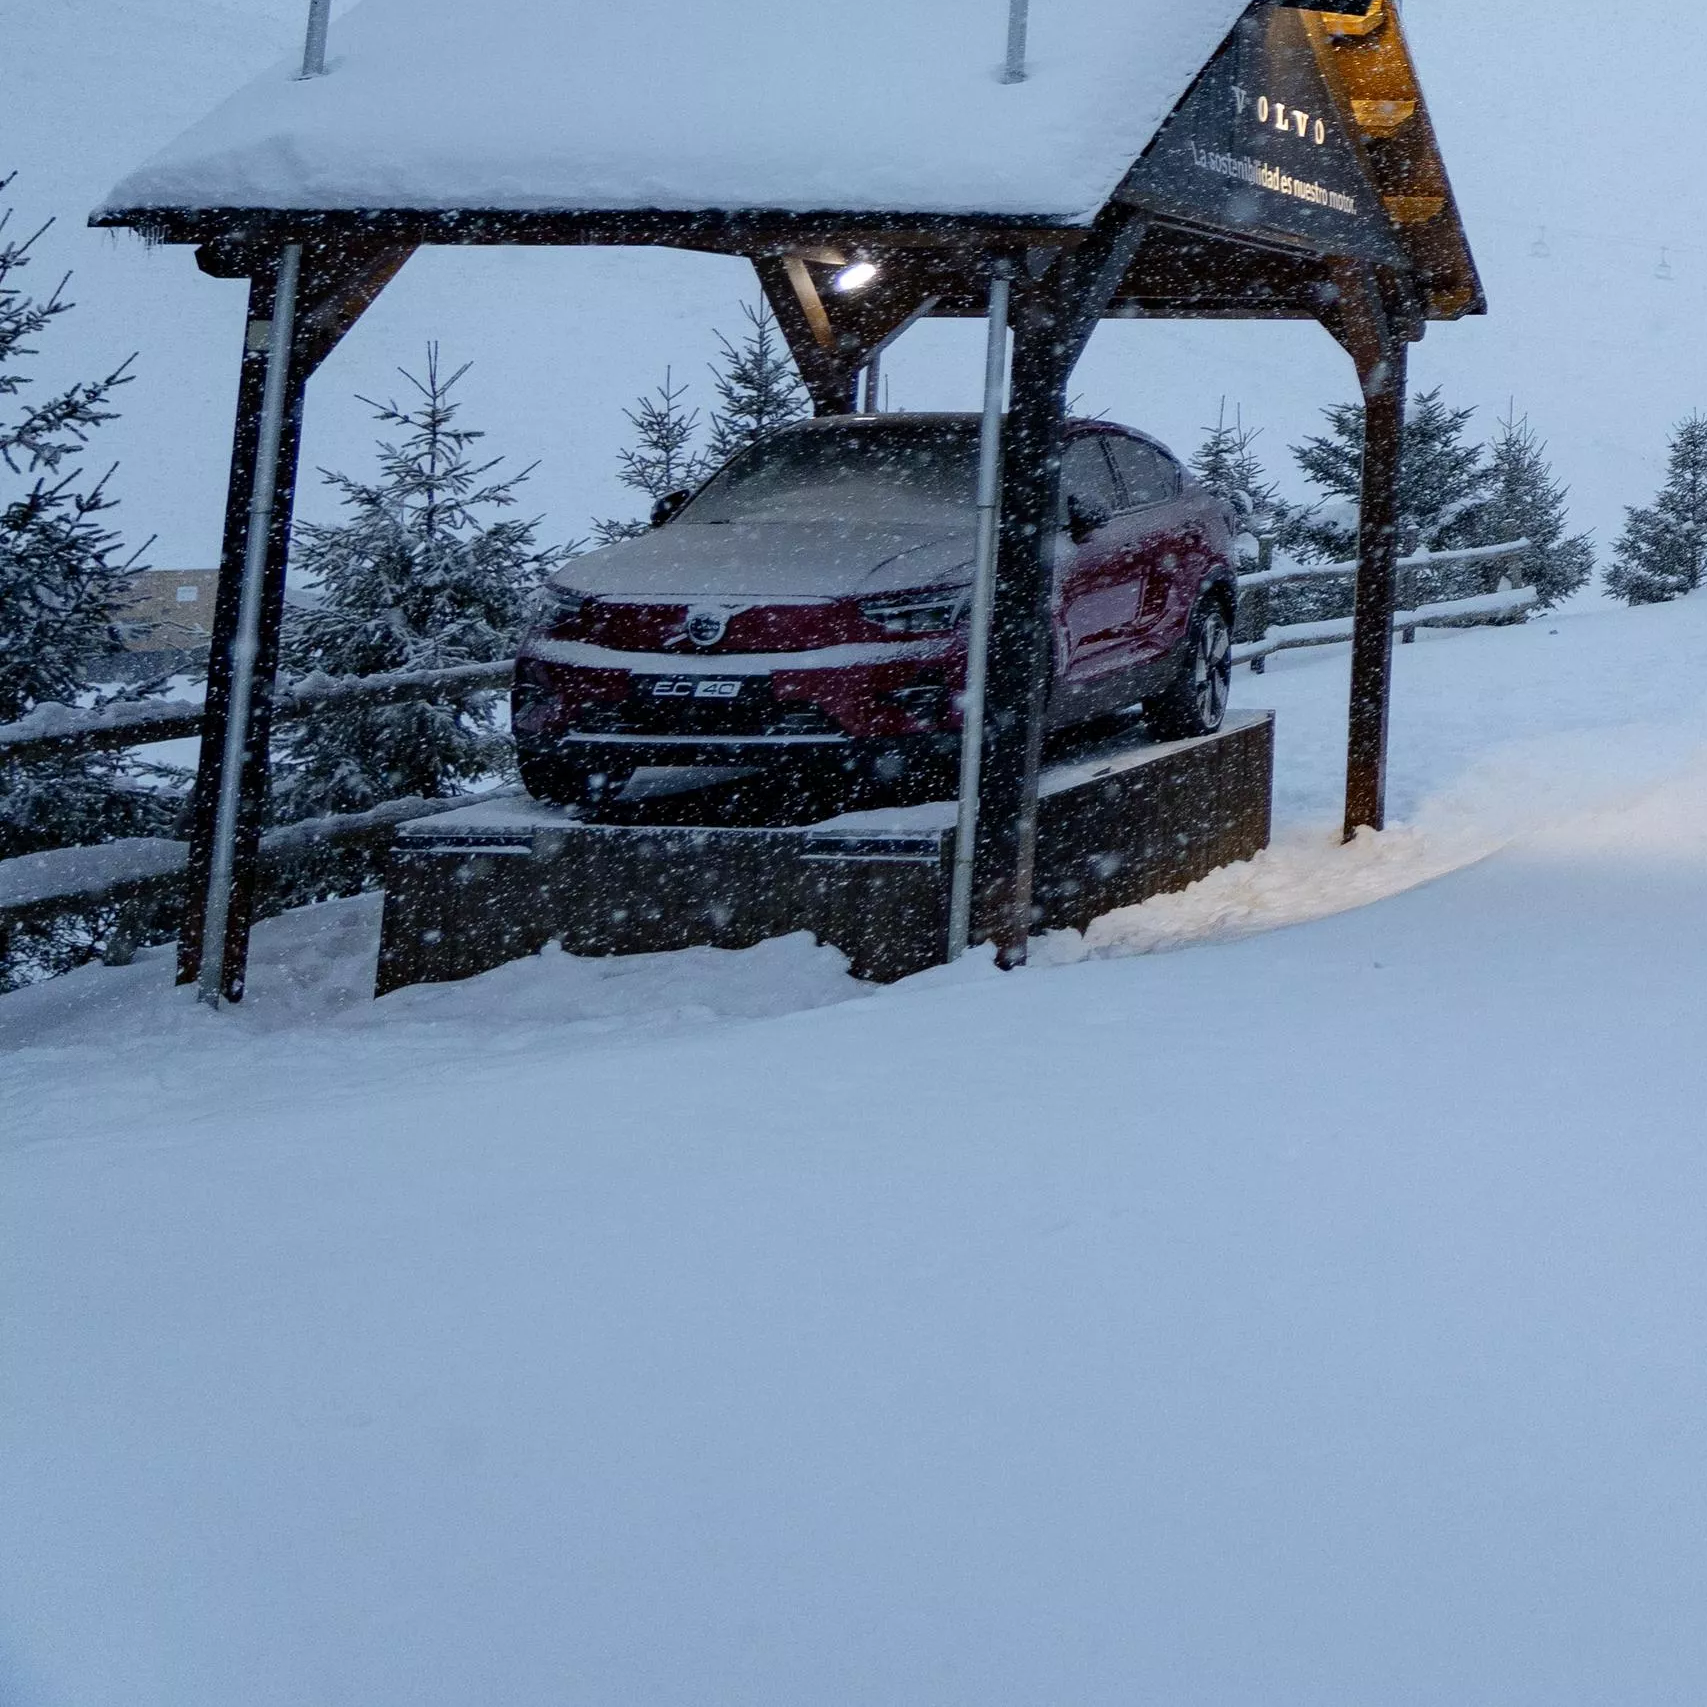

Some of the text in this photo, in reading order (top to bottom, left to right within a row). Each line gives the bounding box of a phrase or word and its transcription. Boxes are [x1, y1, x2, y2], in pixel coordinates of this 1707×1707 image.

[1231, 86, 1325, 145] VOLVO
[1281, 175, 1293, 195] es
[1293, 179, 1328, 206] nuestro
[652, 681, 735, 696] EC 40
